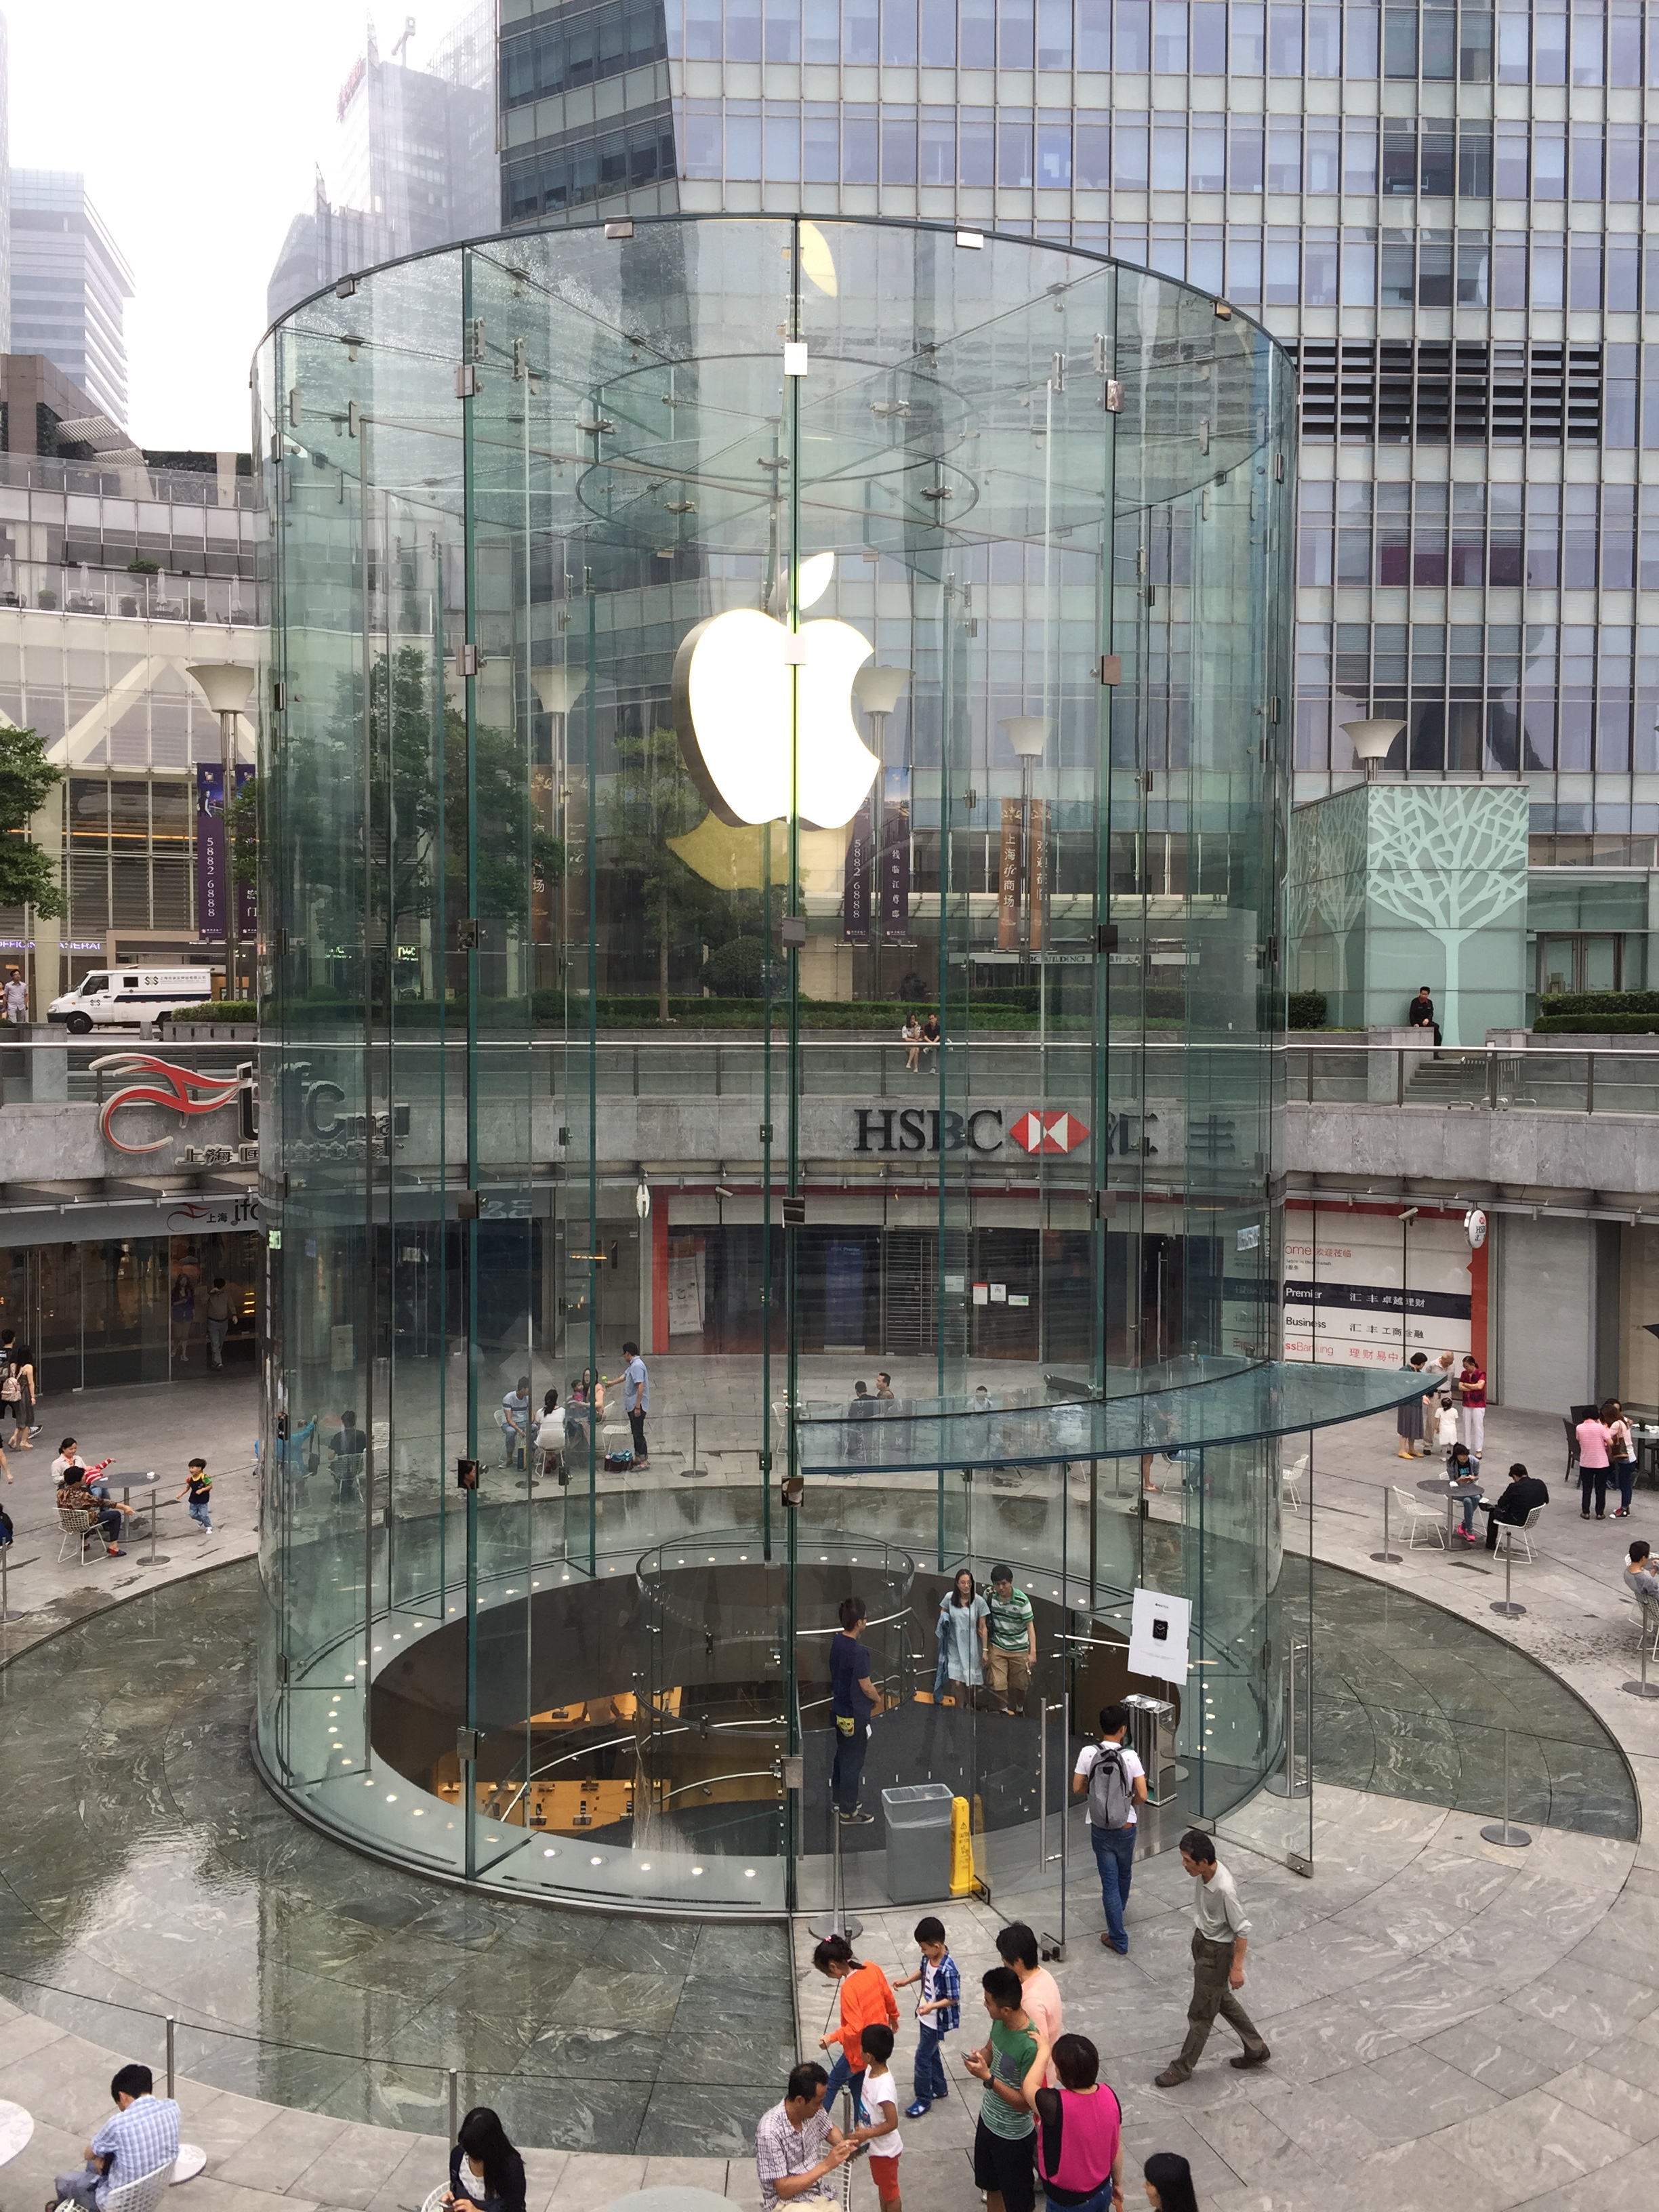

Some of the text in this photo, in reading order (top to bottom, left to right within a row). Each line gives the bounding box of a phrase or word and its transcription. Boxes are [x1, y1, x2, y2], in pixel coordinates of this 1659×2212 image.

[207, 837, 216, 918] 5882 6888
[853, 839, 861, 918] 5882 6888
[1003, 832, 1017, 907] 上海ifc商场
[853, 1109, 1004, 1153] HSBC
[206, 1212, 228, 1223] 上海
[1286, 1287, 1323, 1299] Premier
[1286, 1316, 1327, 1328] Business
